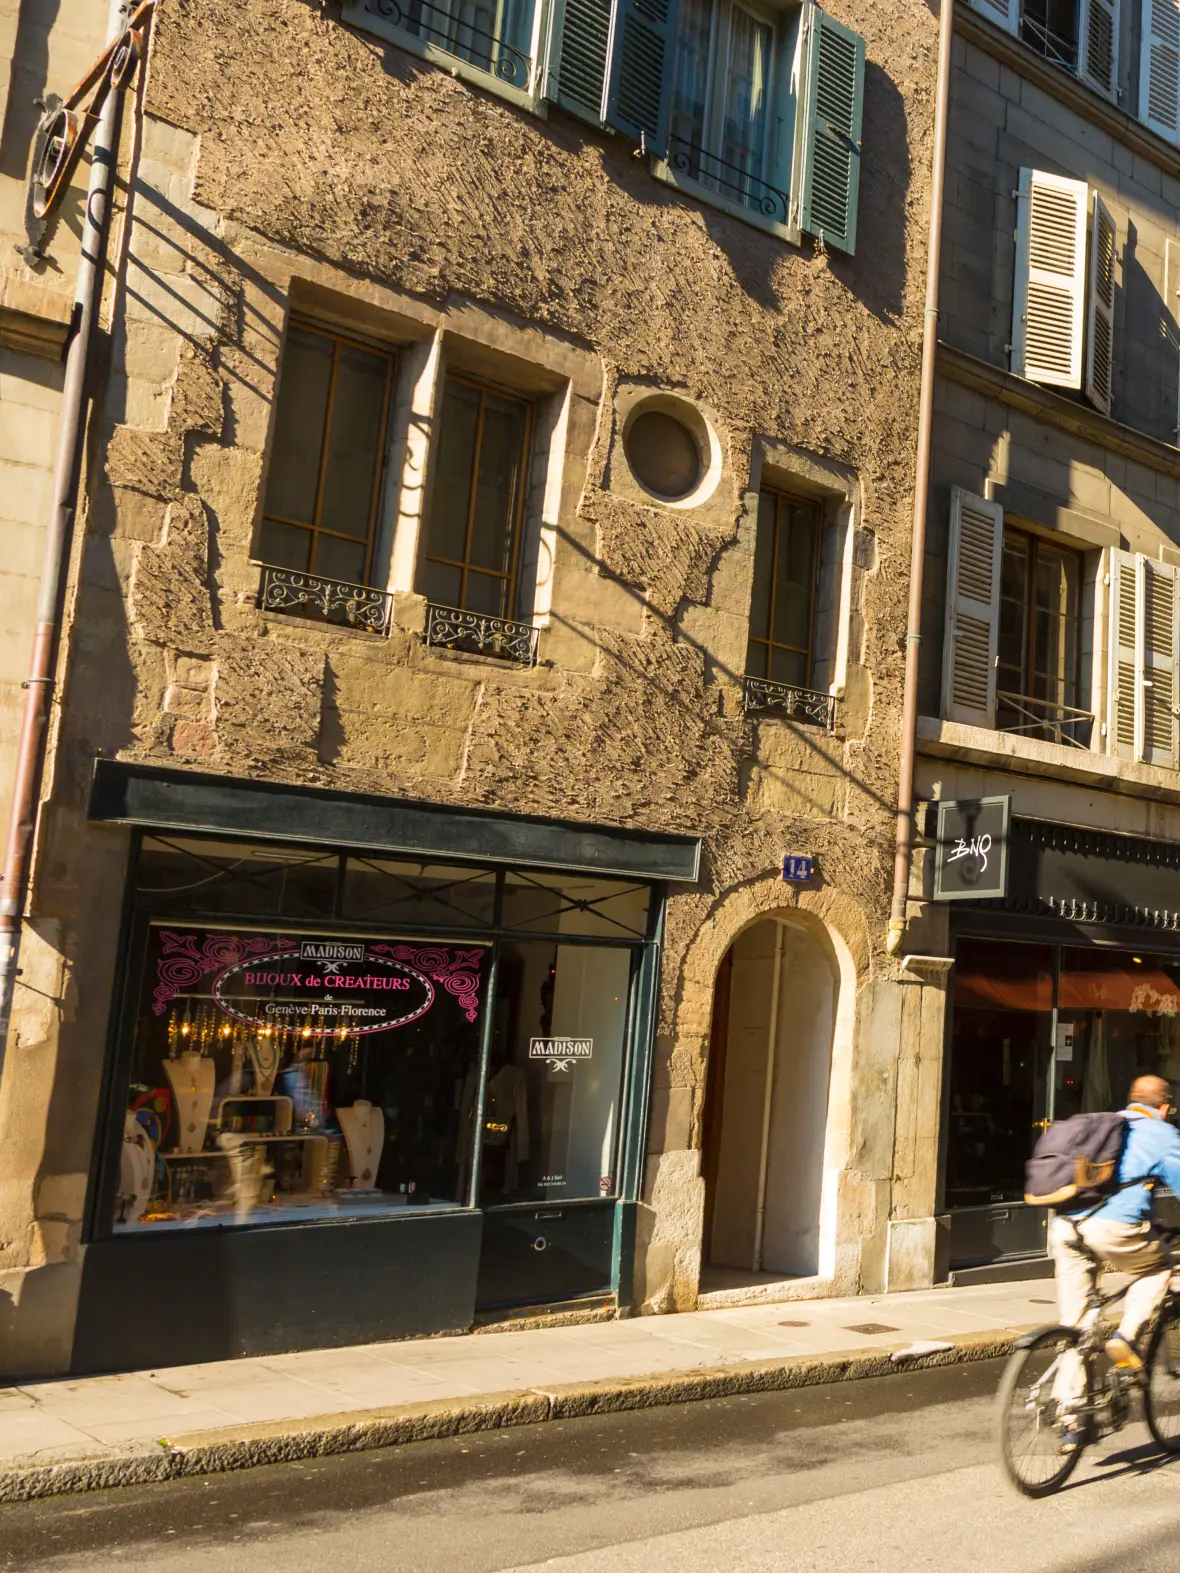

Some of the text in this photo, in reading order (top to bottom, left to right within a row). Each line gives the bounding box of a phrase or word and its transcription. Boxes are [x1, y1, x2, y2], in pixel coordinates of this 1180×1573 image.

[788, 859, 808, 879] 14
[303, 944, 362, 959] MADISON
[244, 973, 411, 990] BIJOUX de CREATEURS
[532, 1041, 590, 1055] MADISON
